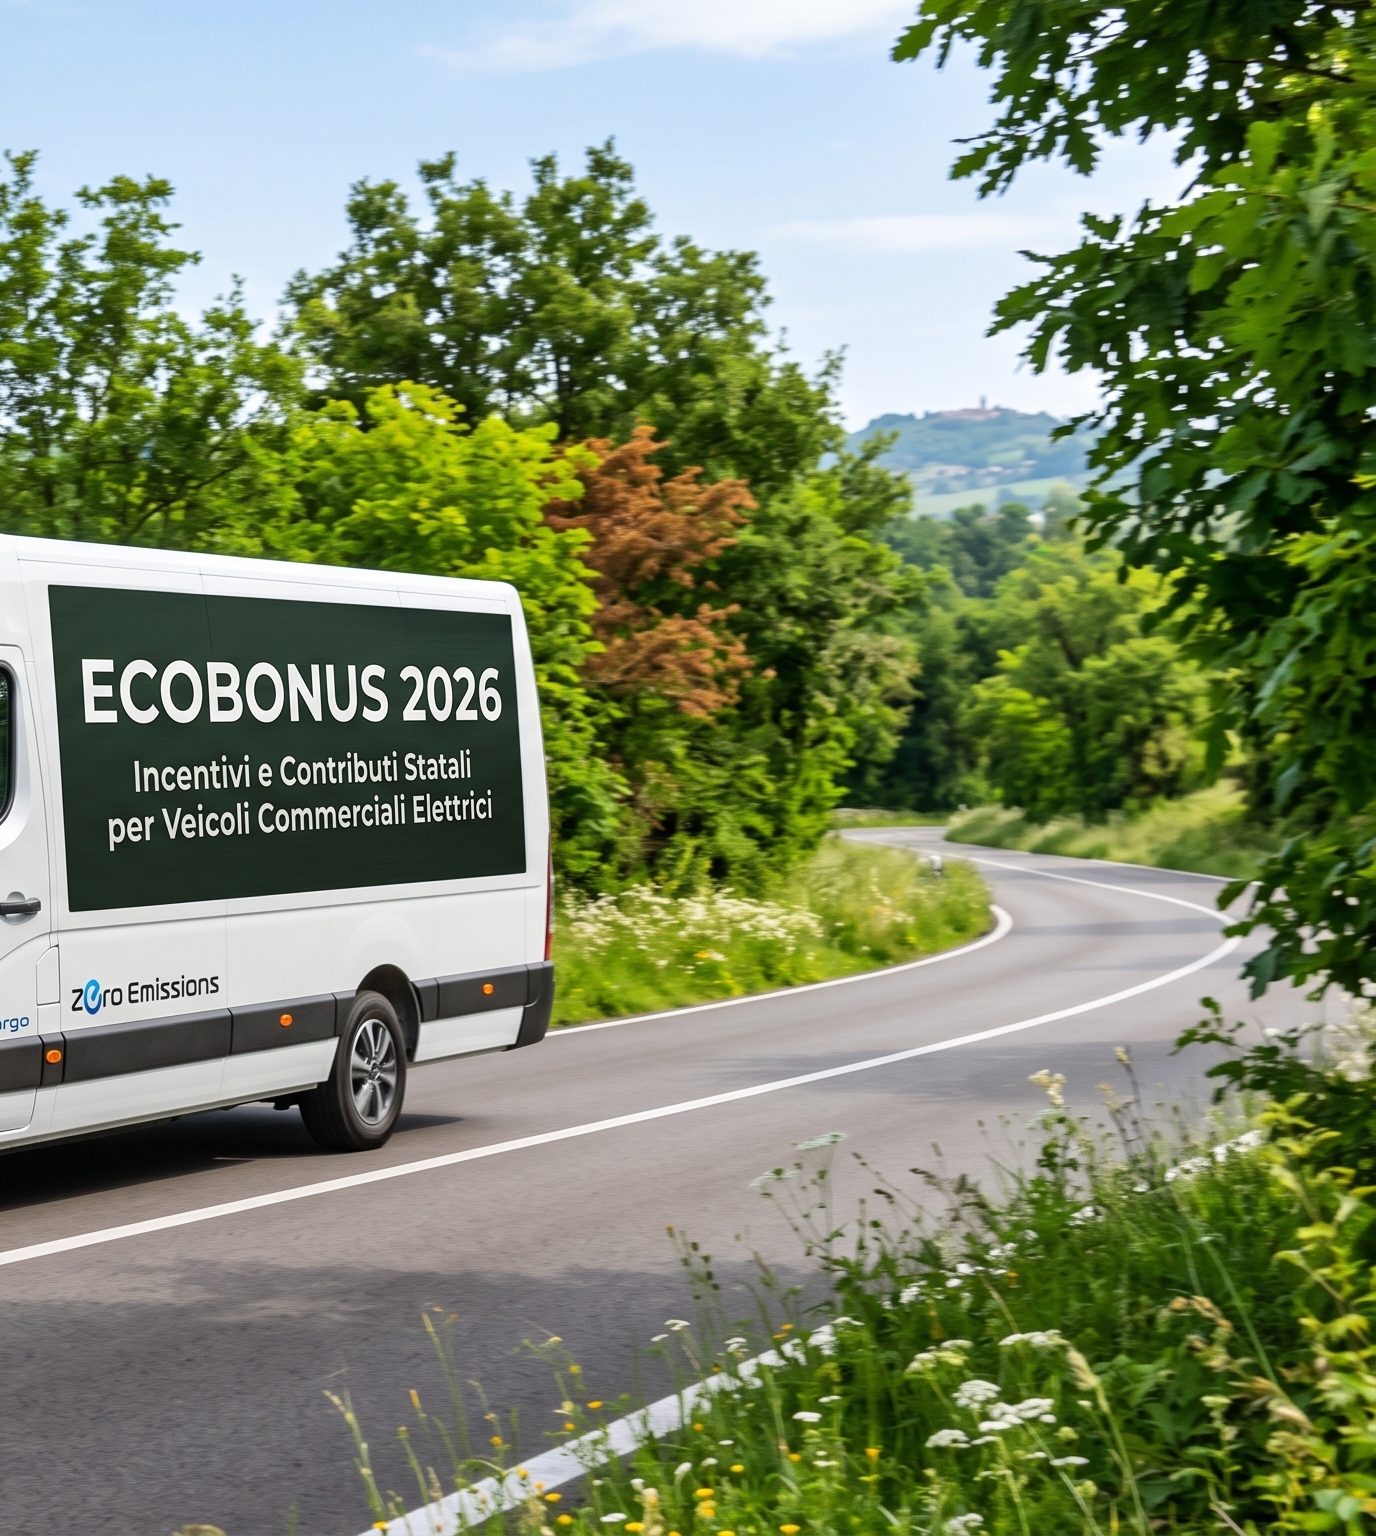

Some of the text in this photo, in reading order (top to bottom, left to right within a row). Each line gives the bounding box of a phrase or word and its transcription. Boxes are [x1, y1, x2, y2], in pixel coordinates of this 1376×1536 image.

[81, 658, 502, 724] ECOBONUS 2026
[133, 748, 472, 793] Incentivi e Contributi Statali
[108, 789, 493, 852] per Veicoli Commerciali Elettrici
[127, 974, 220, 1004] Emissions
